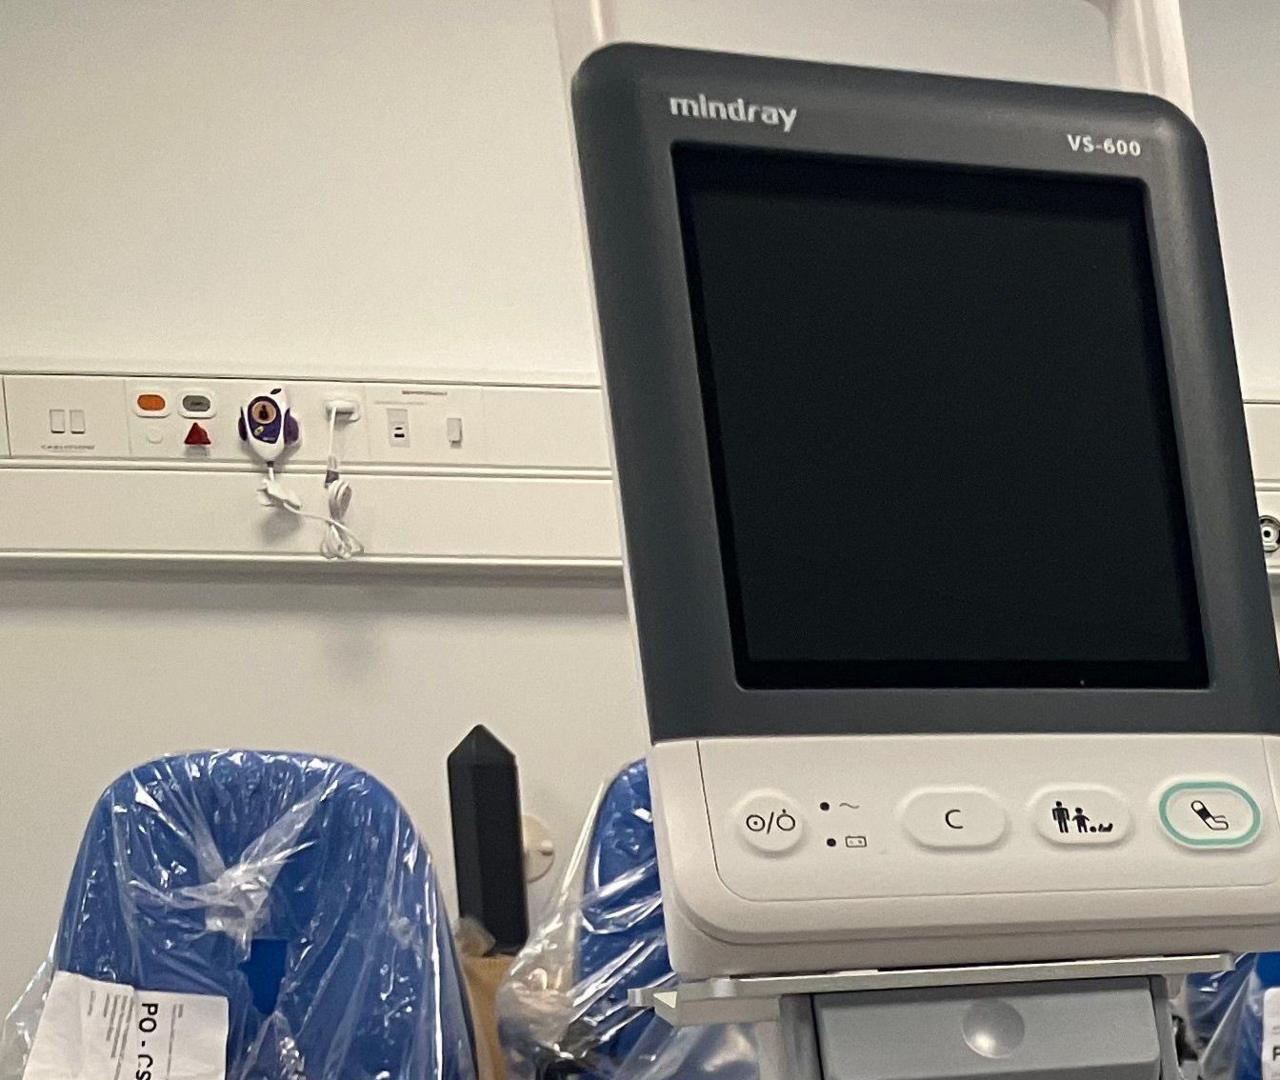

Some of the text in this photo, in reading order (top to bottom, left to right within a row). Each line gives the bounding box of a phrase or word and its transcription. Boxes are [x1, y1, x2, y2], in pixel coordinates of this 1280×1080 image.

[670, 93, 797, 131] mindray
[1067, 134, 1141, 158] VS-600
[945, 809, 963, 829] C
[138, 1002, 158, 1033] PO
